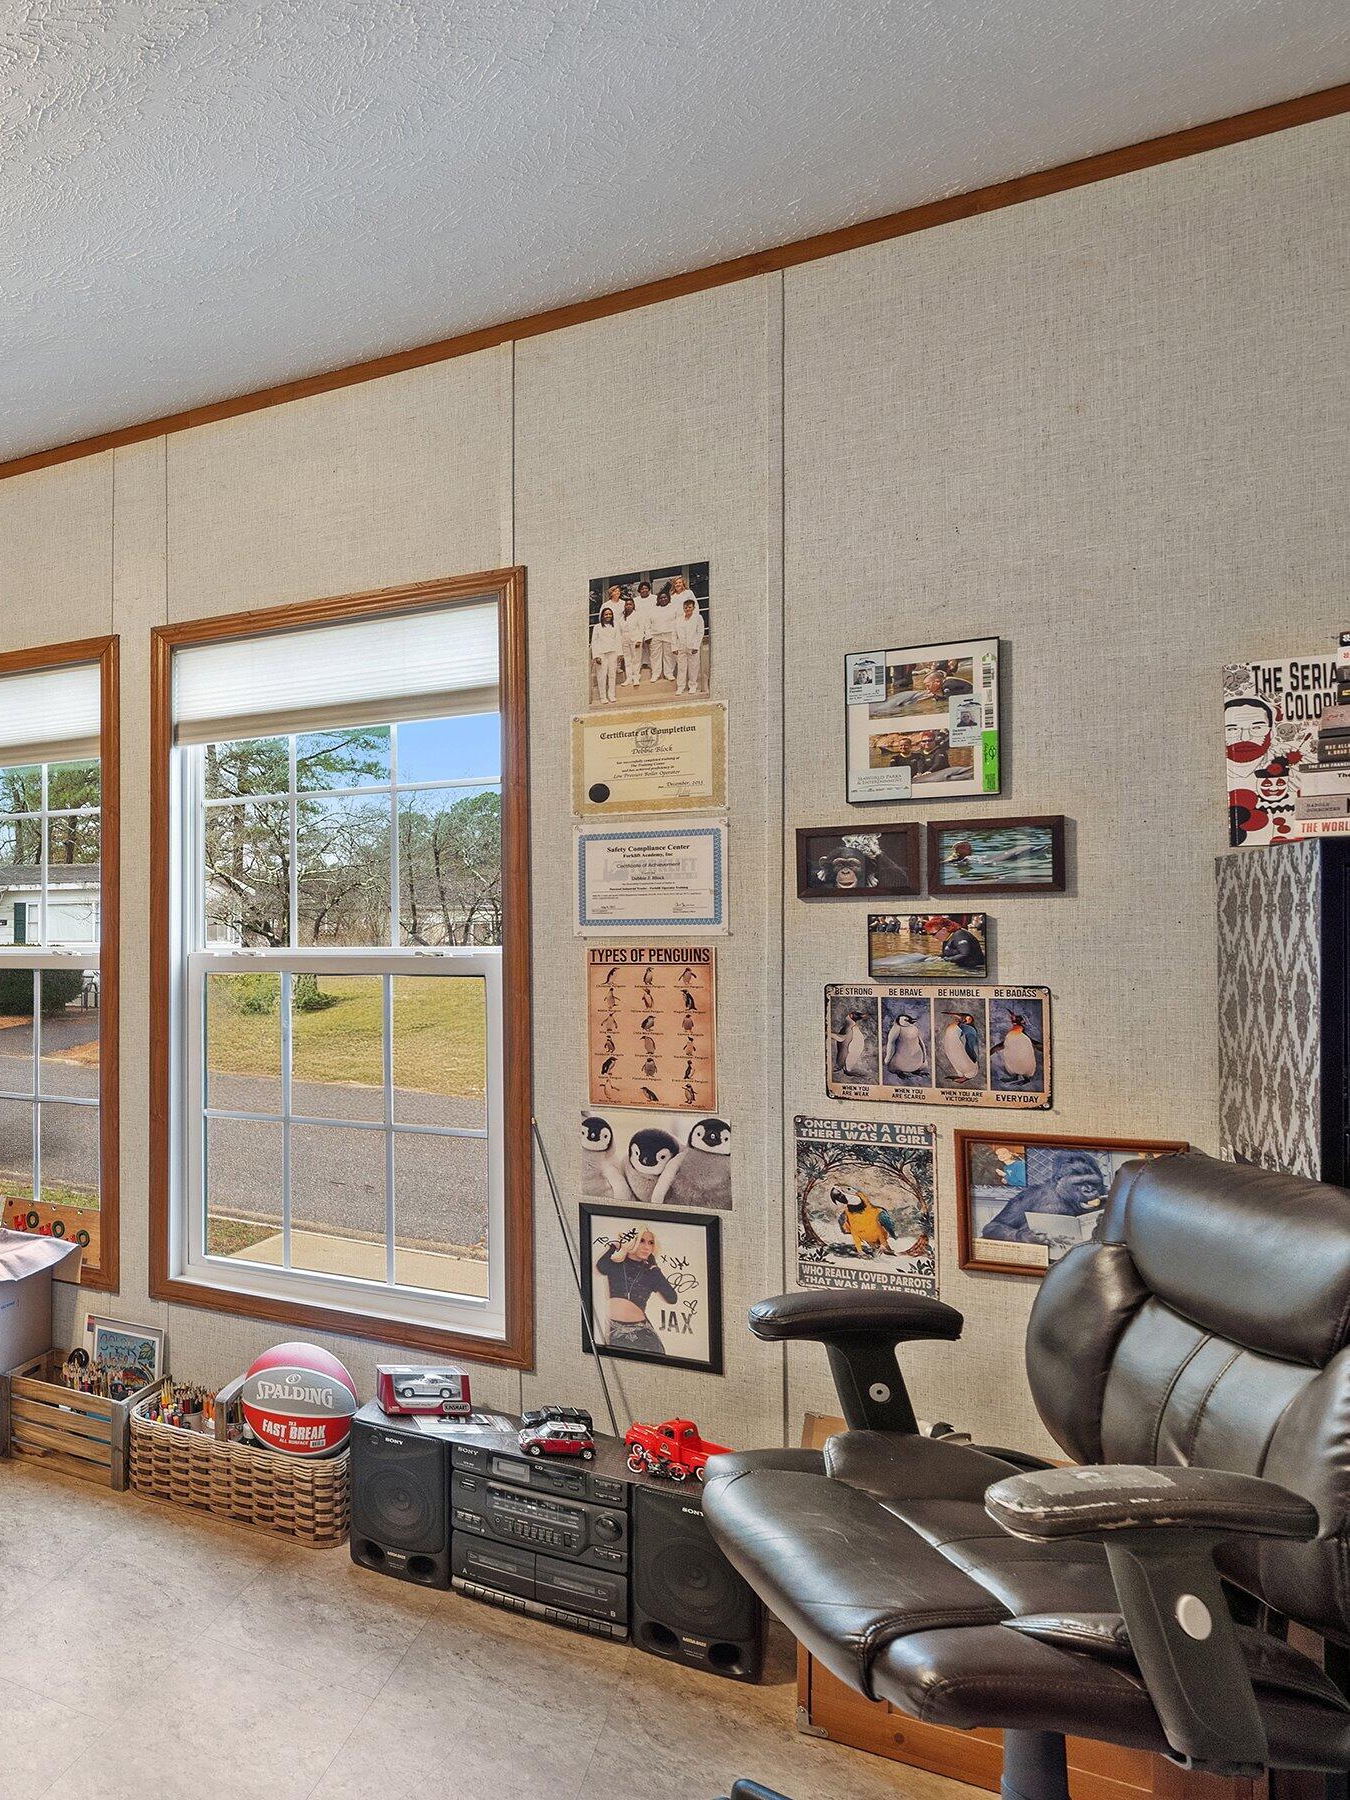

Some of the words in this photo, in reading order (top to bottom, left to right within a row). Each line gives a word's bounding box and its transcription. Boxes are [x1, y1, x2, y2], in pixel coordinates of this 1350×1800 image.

[1252, 665, 1283, 694] THE
[600, 730, 639, 740] Certificate
[640, 728, 649, 737] of
[650, 725, 696, 736] Completion
[632, 747, 653, 755] Debbie
[655, 744, 673, 753] Block
[1302, 822, 1320, 833] THE
[607, 846, 626, 854] Safety
[628, 845, 666, 853] Compliance
[590, 949, 627, 962] TYPES
[630, 948, 645, 962] OF
[649, 948, 710, 962] PENGUINS
[845, 988, 873, 996] STRONG
[888, 988, 898, 996] BE
[899, 988, 923, 996] BRAVE
[949, 989, 980, 997] HUMBLE
[1006, 989, 1037, 998] BADASS
[996, 1094, 1039, 1103] EVERYDAY
[804, 1119, 838, 1130] ONCE
[840, 1121, 878, 1132] UPON
[880, 1124, 891, 1133] A
[893, 1125, 925, 1135] TIME
[800, 1128, 842, 1139] THERE
[844, 1131, 878, 1141] WAS
[882, 1133, 892, 1142] A
[895, 1134, 930, 1145] GIRL
[801, 1265, 824, 1275] WHO
[825, 1267, 857, 1280] REALLY
[858, 1271, 888, 1284] LOVED
[890, 1275, 933, 1290] PARROTS
[805, 1276, 832, 1285] THAT
[834, 1279, 859, 1289] WAS
[659, 1309, 694, 1335] JAX
[256, 1380, 334, 1409] SPALDING
[262, 1418, 287, 1438] FAST
[290, 1425, 326, 1440] BREAK
[385, 1437, 404, 1445] SONY
[457, 1446, 479, 1456] SONY
